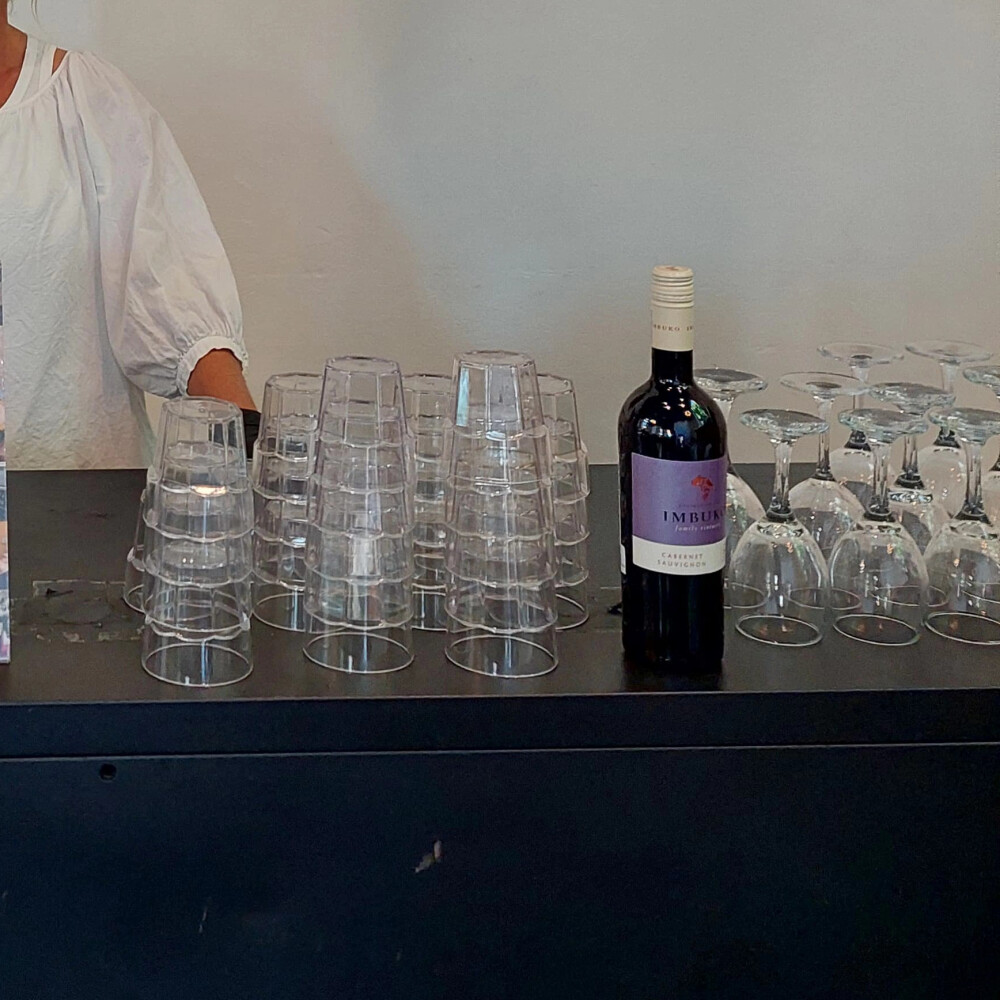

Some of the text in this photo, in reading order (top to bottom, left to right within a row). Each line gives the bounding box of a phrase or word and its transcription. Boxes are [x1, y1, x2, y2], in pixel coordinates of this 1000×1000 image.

[663, 508, 724, 524] IMBUK
[661, 551, 703, 560] CABERNET
[657, 559, 706, 568] SAUVIGNON
